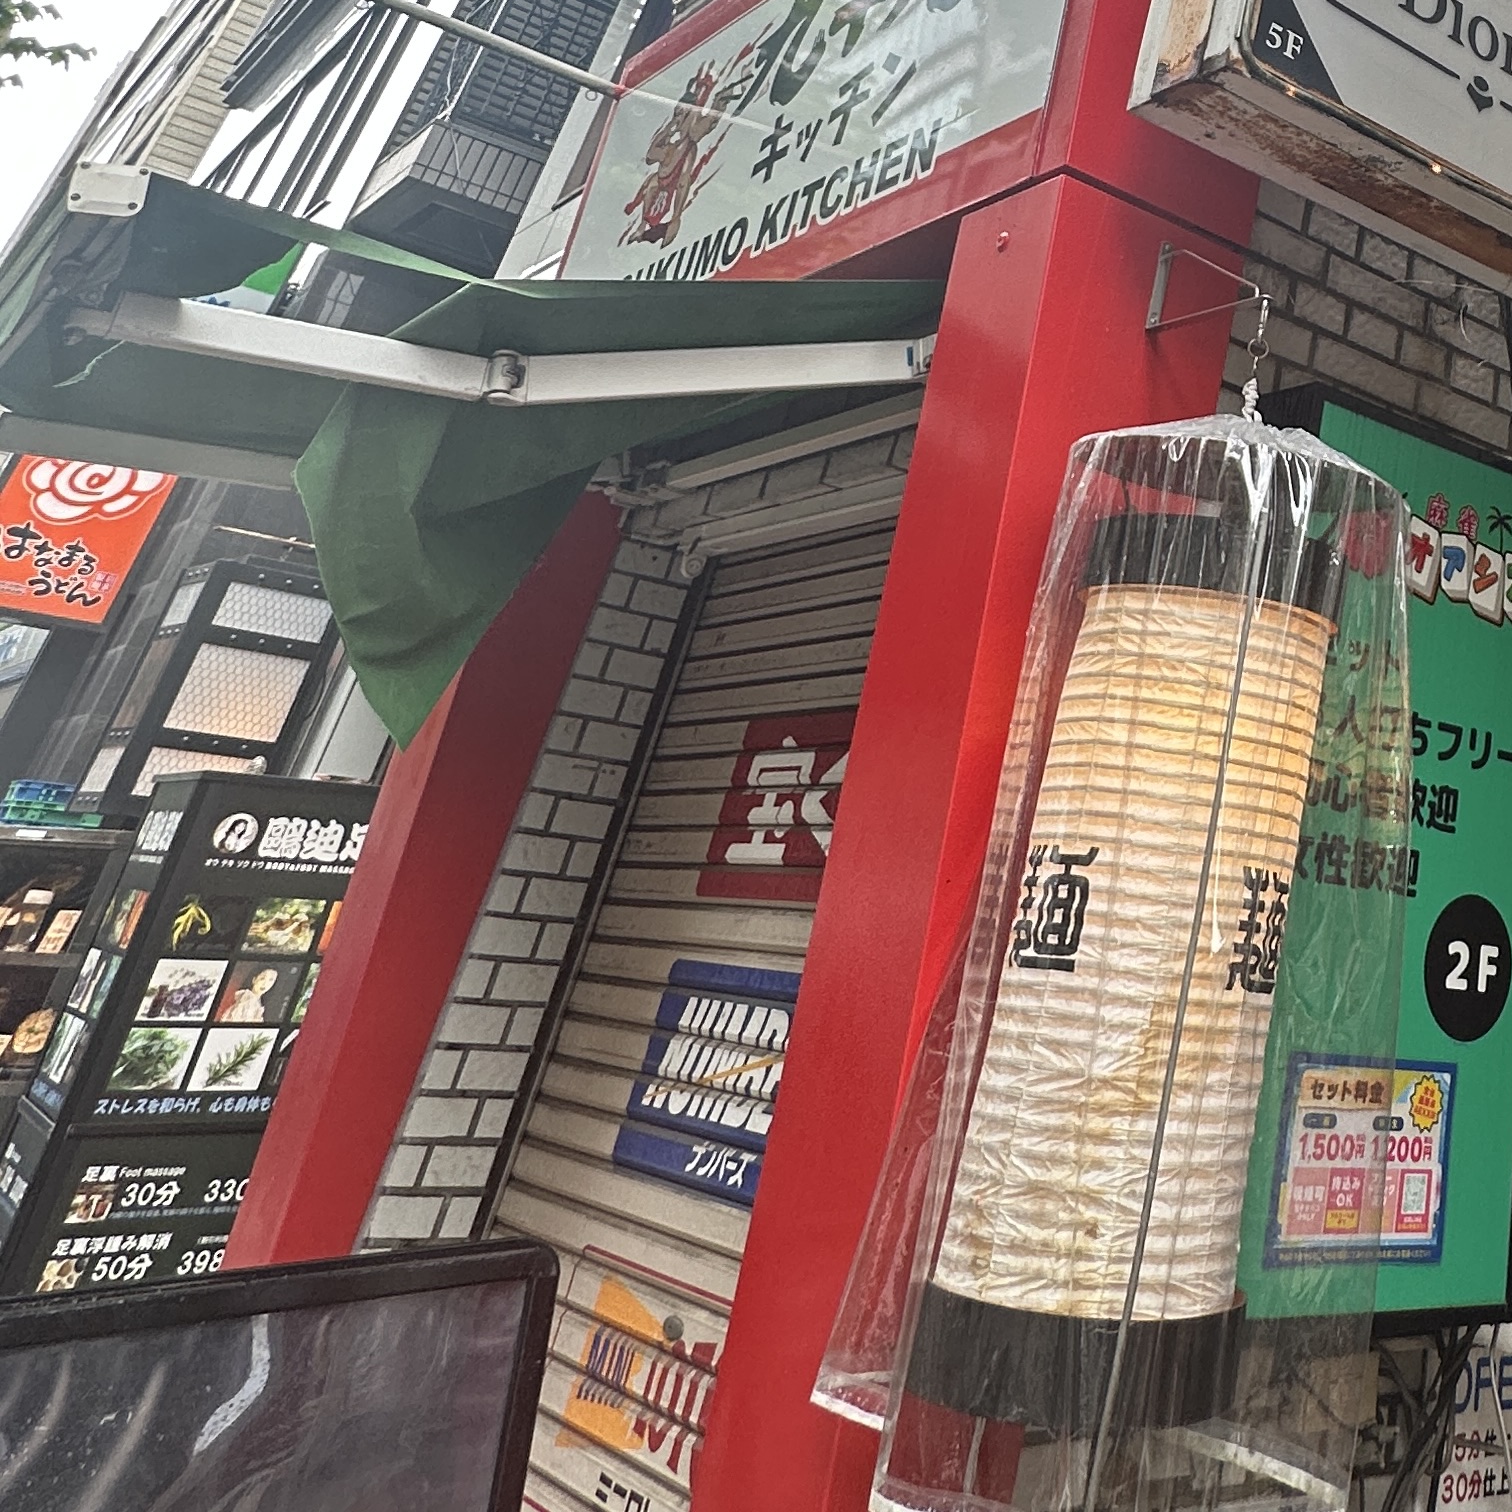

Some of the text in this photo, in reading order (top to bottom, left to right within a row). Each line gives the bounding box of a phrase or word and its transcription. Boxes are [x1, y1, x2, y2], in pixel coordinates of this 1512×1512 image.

[1265, 22, 1304, 60] 5F
[750, 51, 918, 184] キッチン
[753, 117, 942, 253] KITCHEN
[1427, 493, 1478, 539] 麻雀
[28, 570, 101, 606] うどん
[724, 735, 852, 866] 宝く
[1445, 940, 1499, 994] 2F
[685, 1140, 757, 1188] ナンバーズ
[121, 1181, 180, 1207] 30分
[92, 1249, 226, 1282] 50分 398
